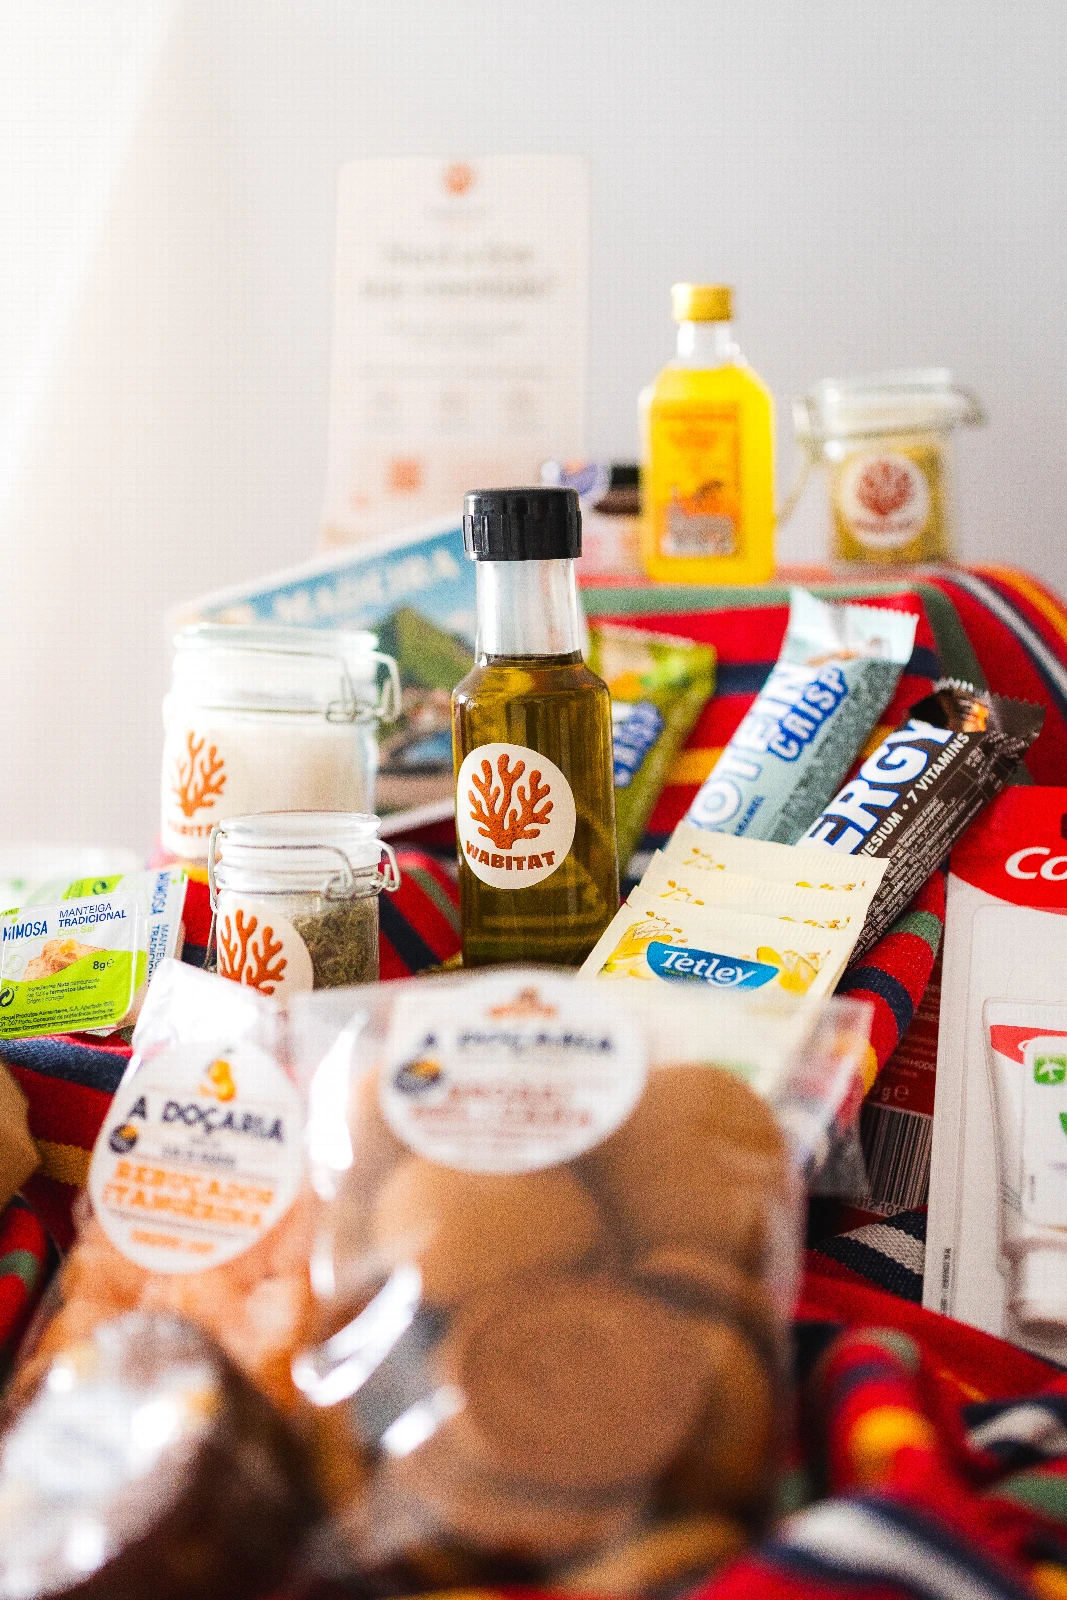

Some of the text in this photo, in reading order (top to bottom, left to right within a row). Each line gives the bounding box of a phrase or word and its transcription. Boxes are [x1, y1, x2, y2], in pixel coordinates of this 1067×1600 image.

[770, 667, 846, 760] CRISP
[915, 732, 970, 791] VITAMINS
[466, 840, 555, 870] WABITAT
[150, 872, 170, 915] MIMOSA
[59, 910, 127, 927] TRADICIONAL
[60, 903, 112, 918] MANTEIGA
[3, 920, 48, 941] MIMOSA
[57, 925, 95, 937] Com Sal
[660, 950, 757, 987] Tetley
[127, 1095, 285, 1143] A DOÇARIA
